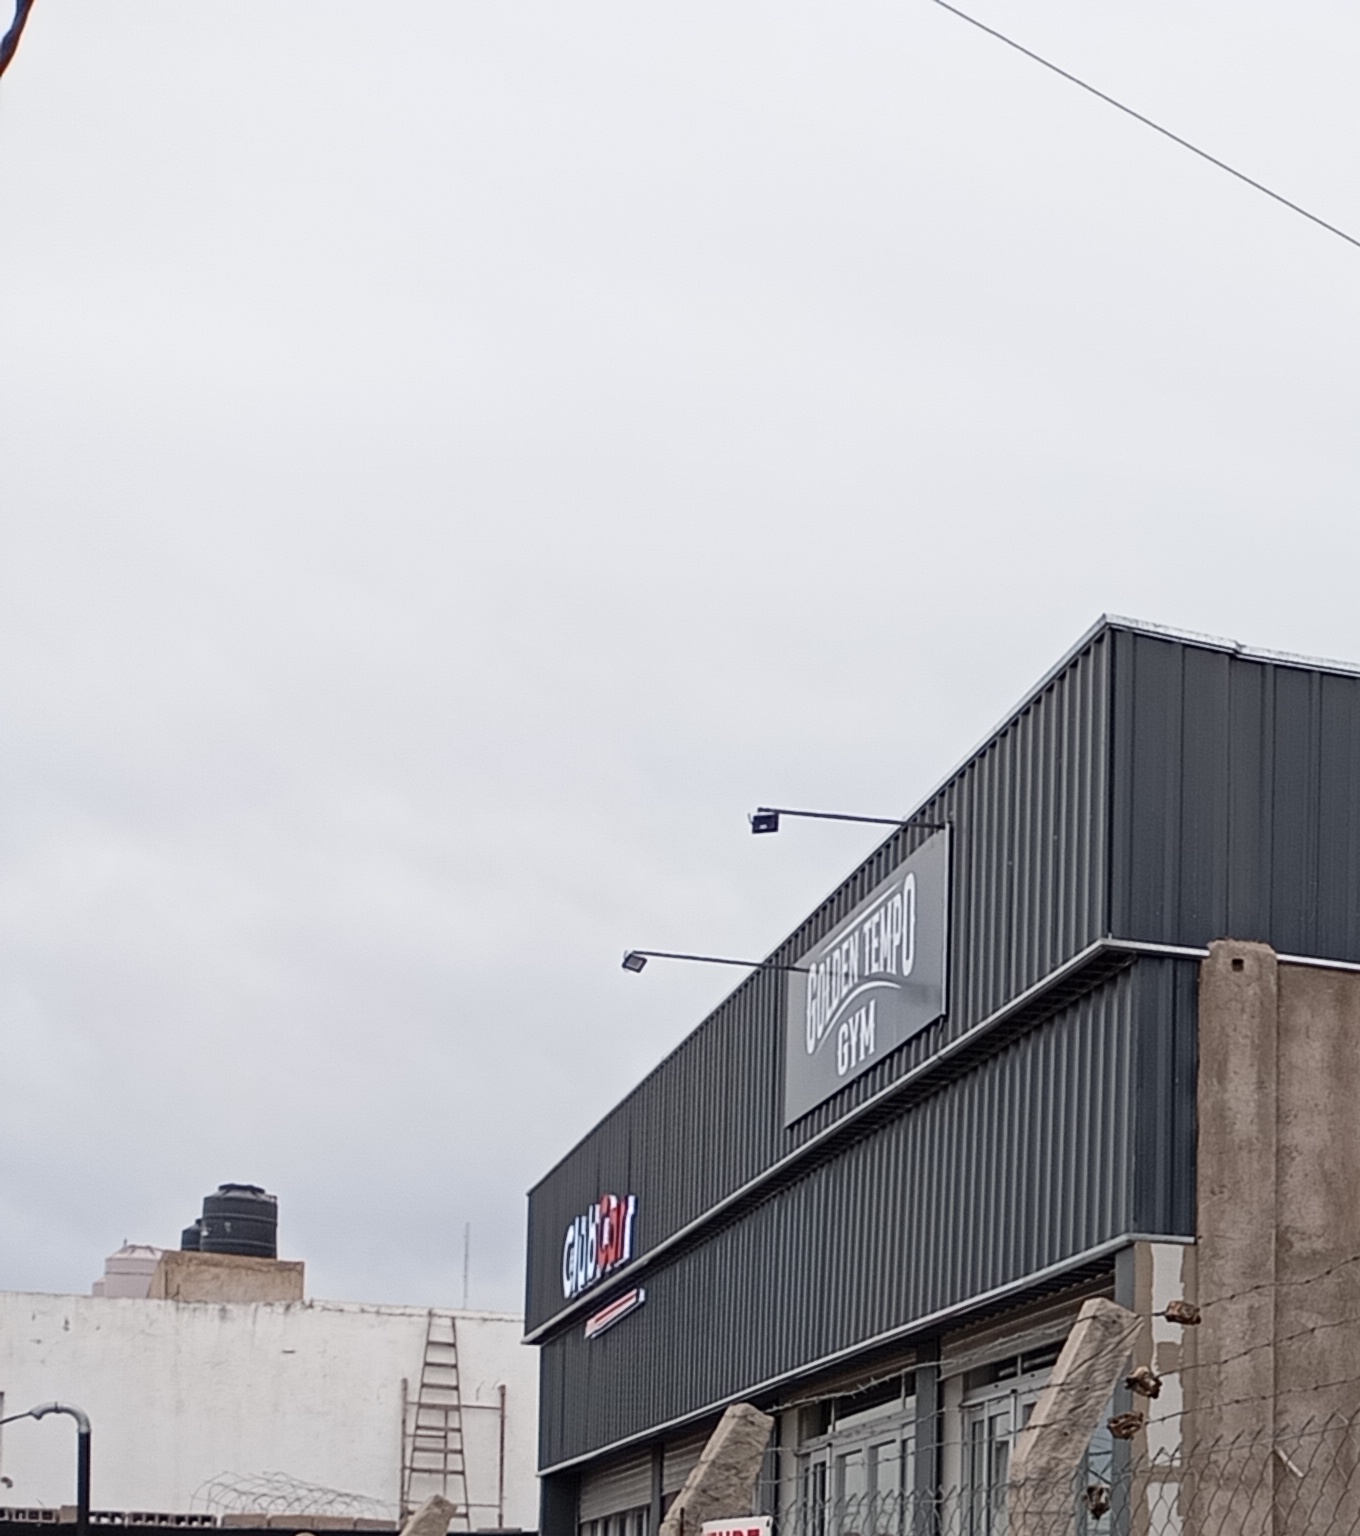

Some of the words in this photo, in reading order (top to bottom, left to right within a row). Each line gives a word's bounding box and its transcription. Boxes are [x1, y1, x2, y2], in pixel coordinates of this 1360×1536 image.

[806, 931, 860, 1054] GOLDEN
[863, 872, 916, 977] TEMPO
[837, 999, 876, 1076] GYM
